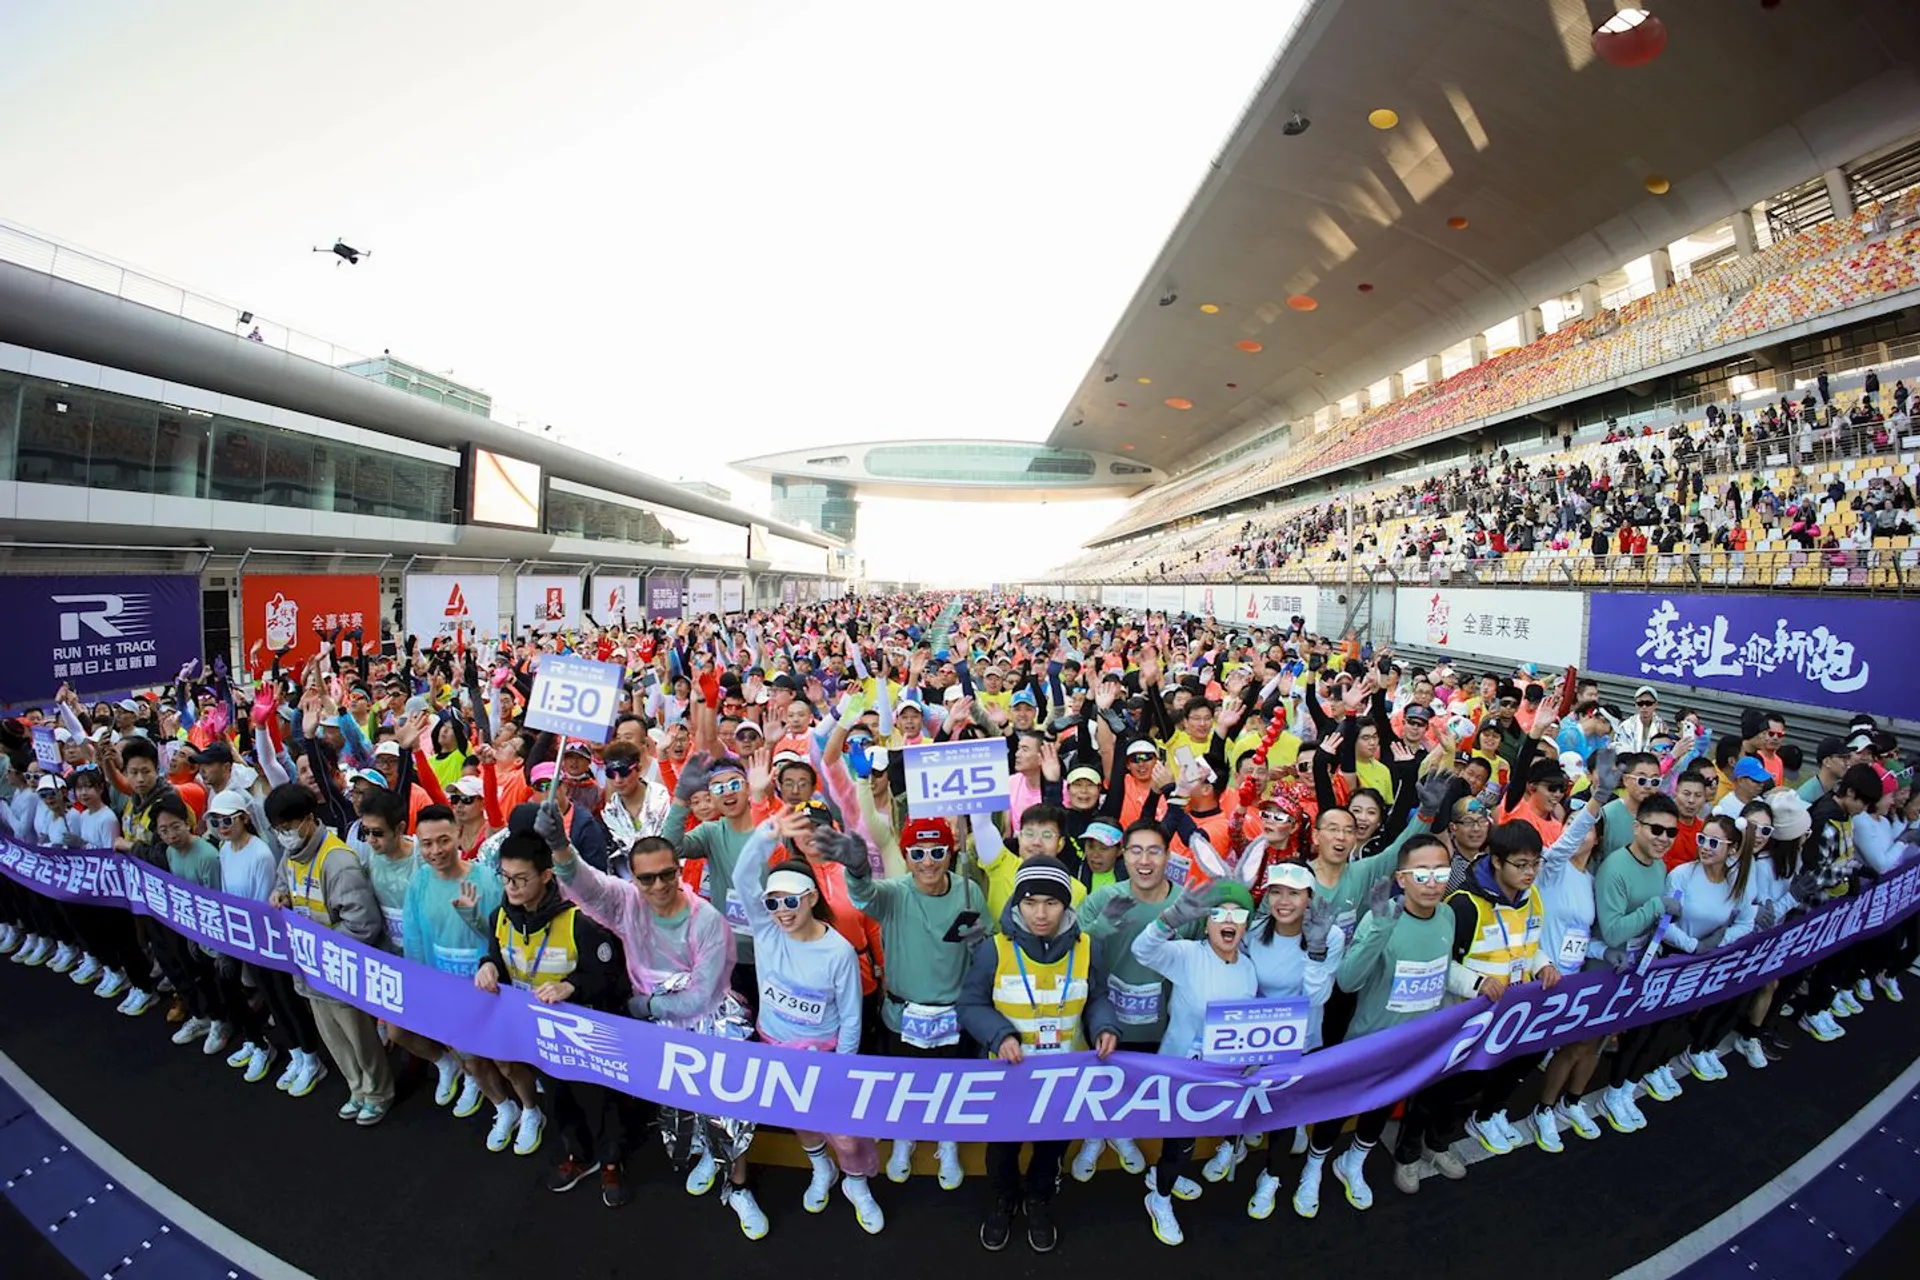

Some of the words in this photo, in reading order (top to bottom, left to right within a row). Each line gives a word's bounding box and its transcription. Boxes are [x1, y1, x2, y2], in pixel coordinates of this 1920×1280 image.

[311, 612, 363, 631] 全嘉来赛
[1462, 612, 1531, 641] 全嘉来赛
[53, 646, 82, 660] RUN
[86, 643, 112, 657] THE
[115, 640, 156, 654] TRACK
[540, 681, 601, 718] 1:30
[920, 766, 996, 799] 1:45
[937, 801, 983, 812] PACER
[1395, 974, 1445, 995] A5458
[764, 987, 821, 1015] A7360
[1108, 990, 1158, 1010] A3215
[1213, 1025, 1298, 1051] 2:00
[536, 1037, 559, 1053] RUN
[562, 1044, 586, 1058] THE
[588, 1053, 628, 1073] TRACK
[1229, 1055, 1275, 1063] PACER
[657, 1041, 821, 1114] RUN
[847, 1069, 1006, 1125] THE
[1027, 1064, 1304, 1125] TRACK
